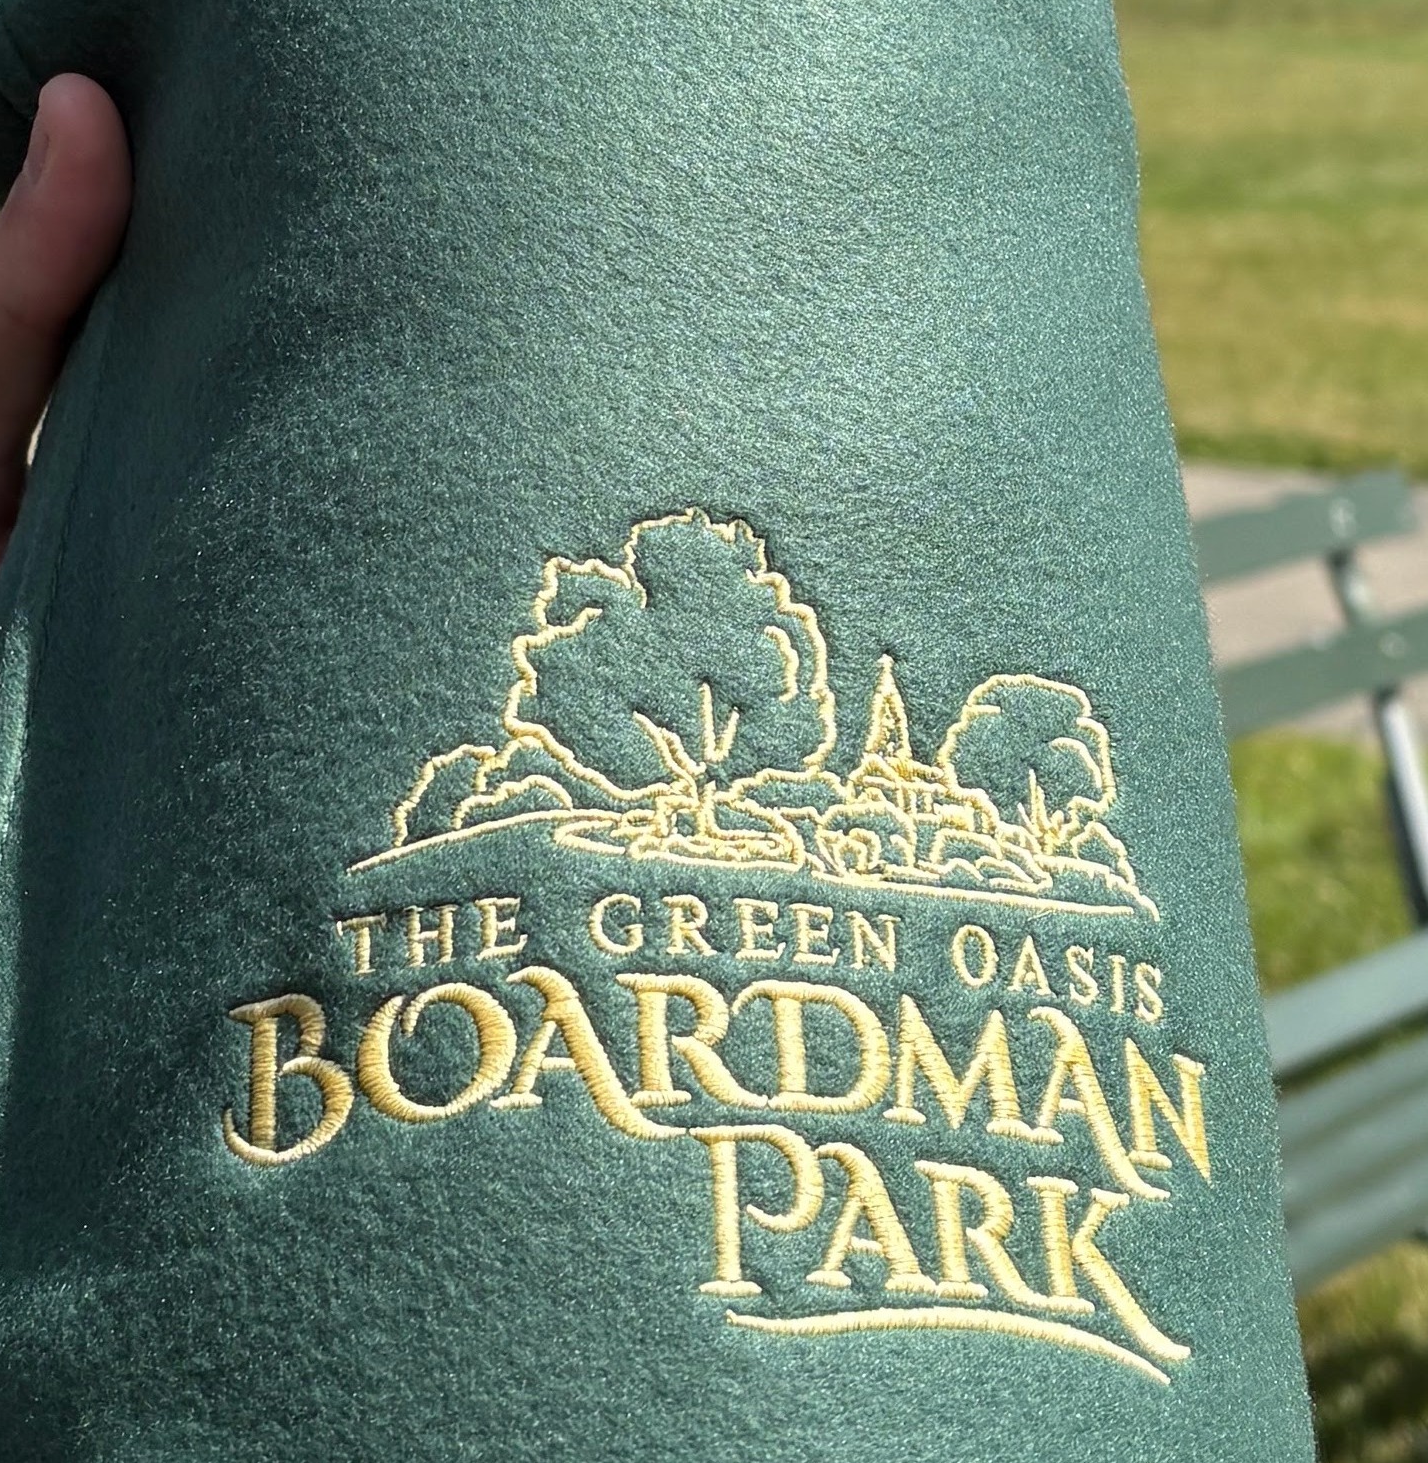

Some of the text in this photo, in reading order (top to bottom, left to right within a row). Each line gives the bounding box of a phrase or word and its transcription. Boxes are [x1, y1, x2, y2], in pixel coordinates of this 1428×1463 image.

[336, 892, 1167, 1023] THE GREEN OASIS
[222, 965, 1212, 1200] BOARDMAN
[688, 1124, 1191, 1361] PARK
